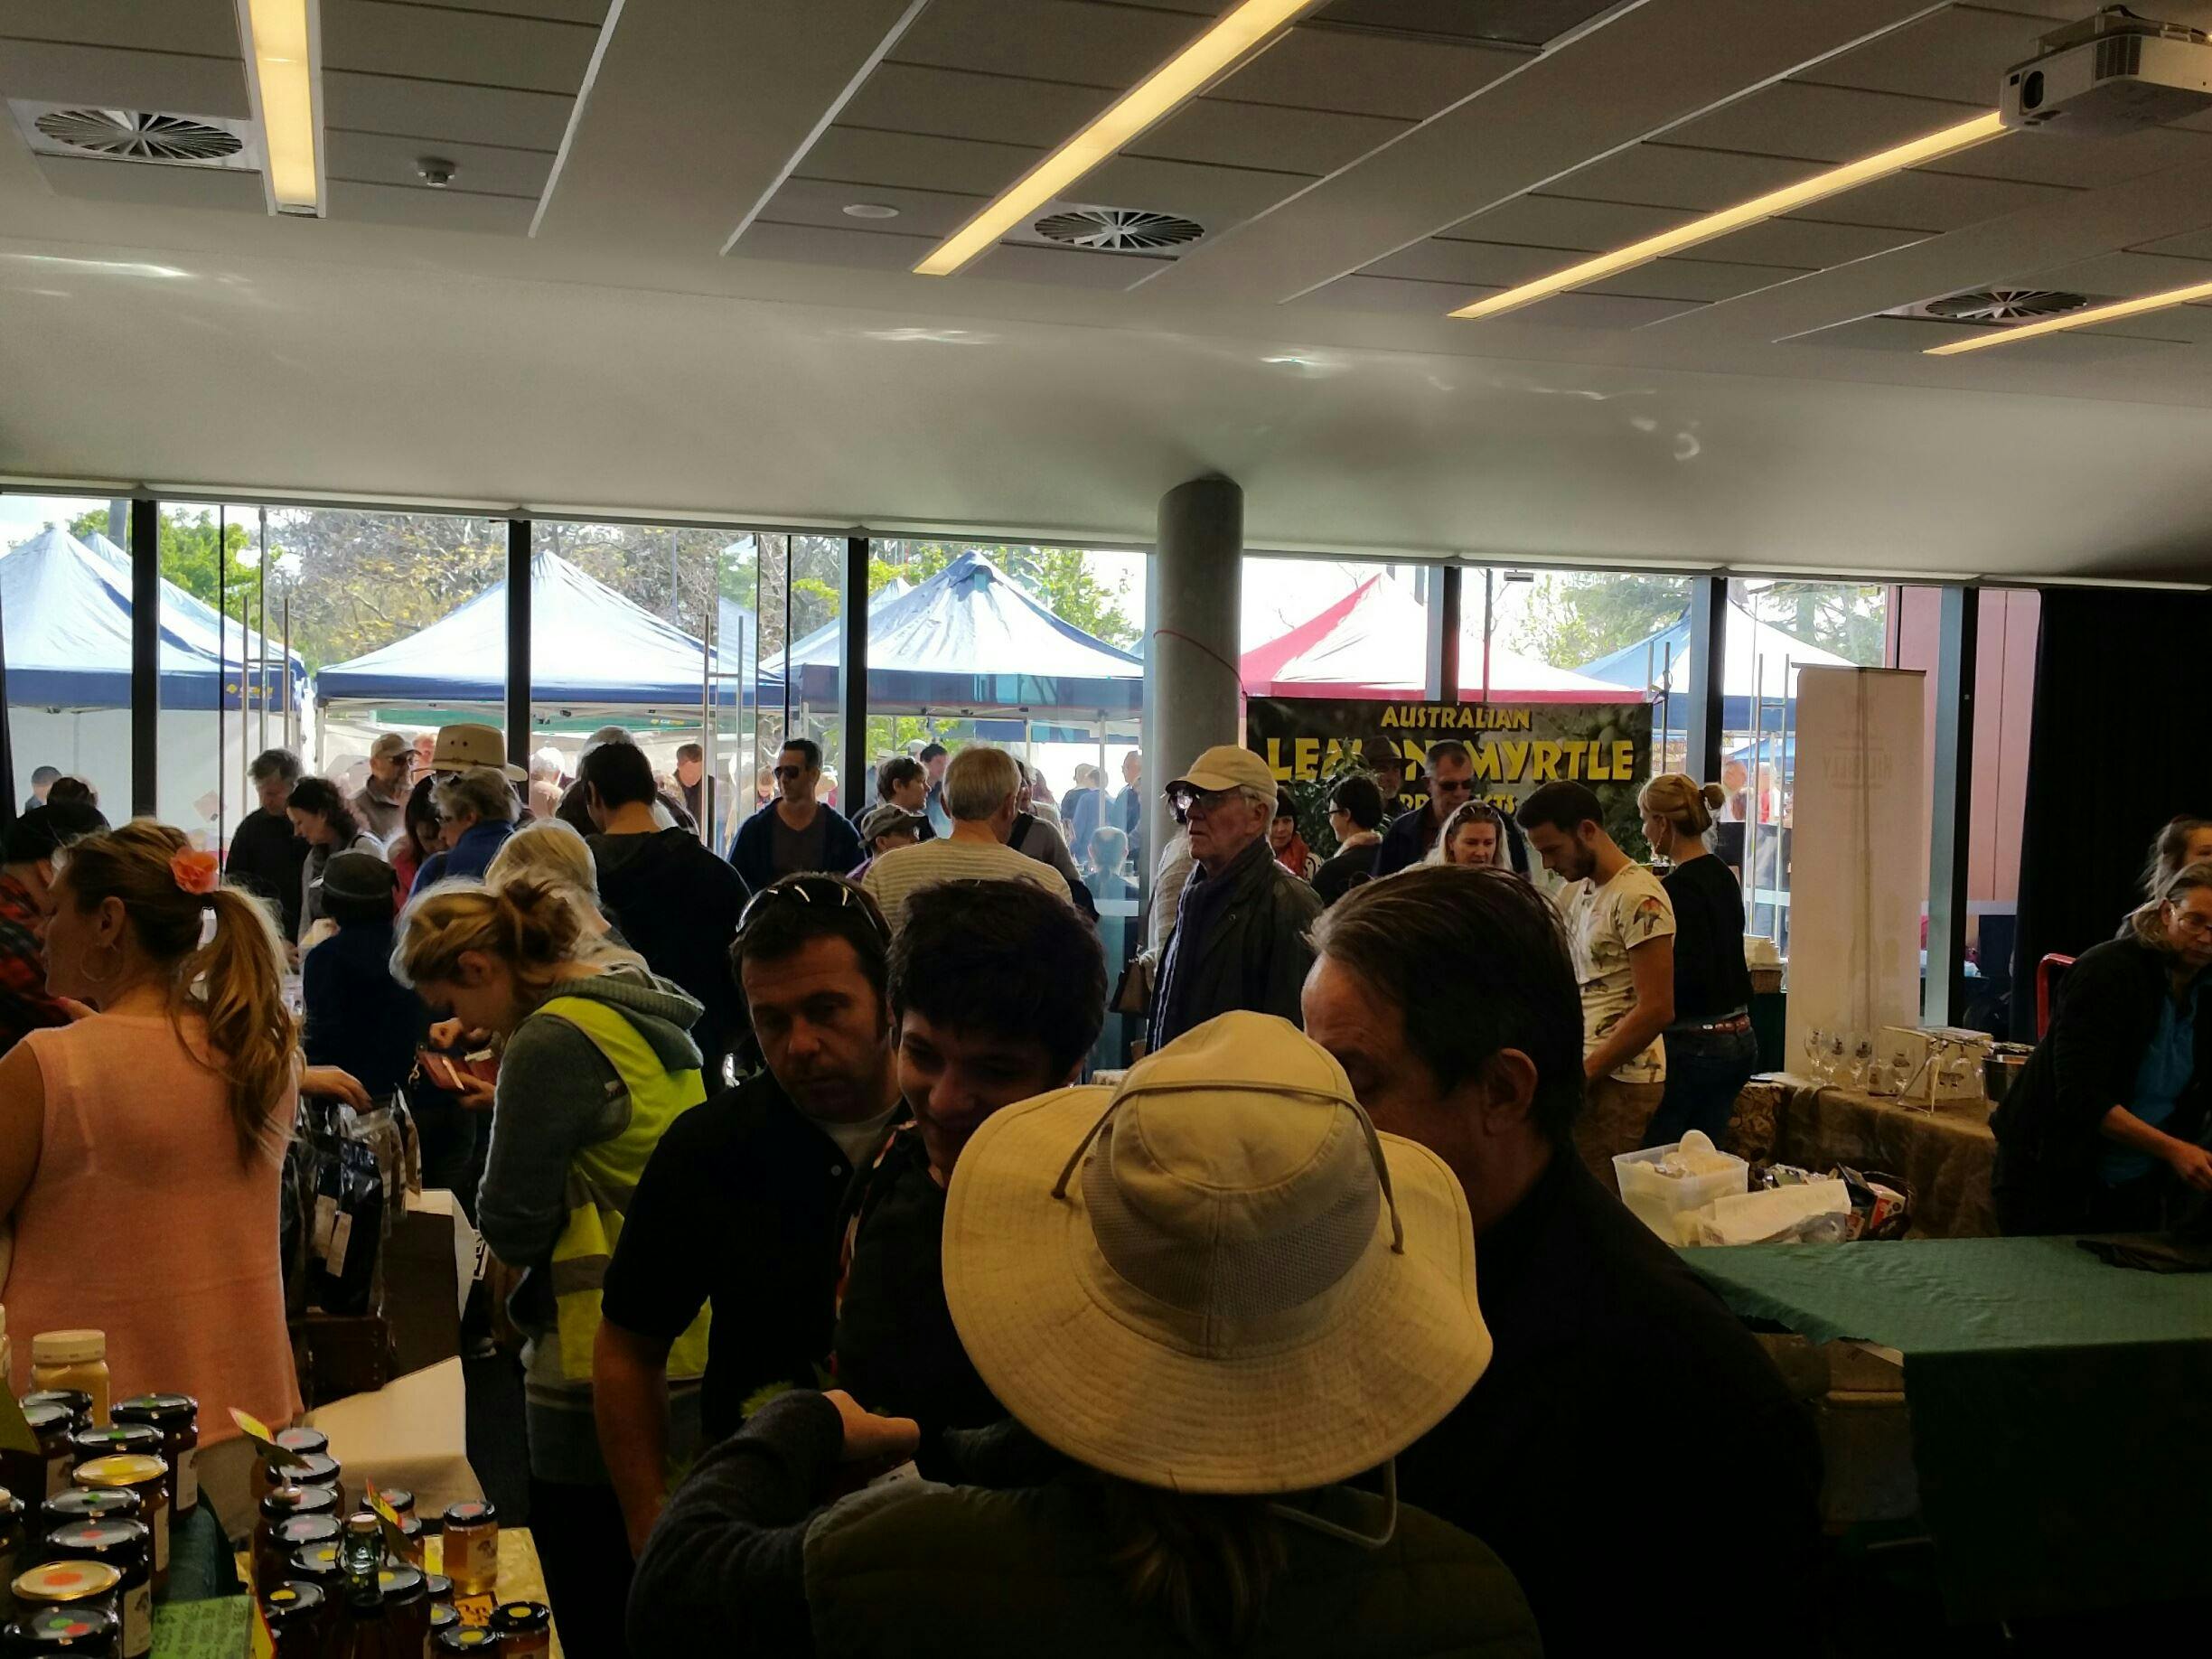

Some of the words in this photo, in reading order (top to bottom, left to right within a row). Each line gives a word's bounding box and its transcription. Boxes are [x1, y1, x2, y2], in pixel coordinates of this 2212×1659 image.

[1380, 704, 1531, 729] AUSTRALIAN
[1267, 736, 1438, 782] LEMN
[1461, 739, 1634, 783] MYRTLE
